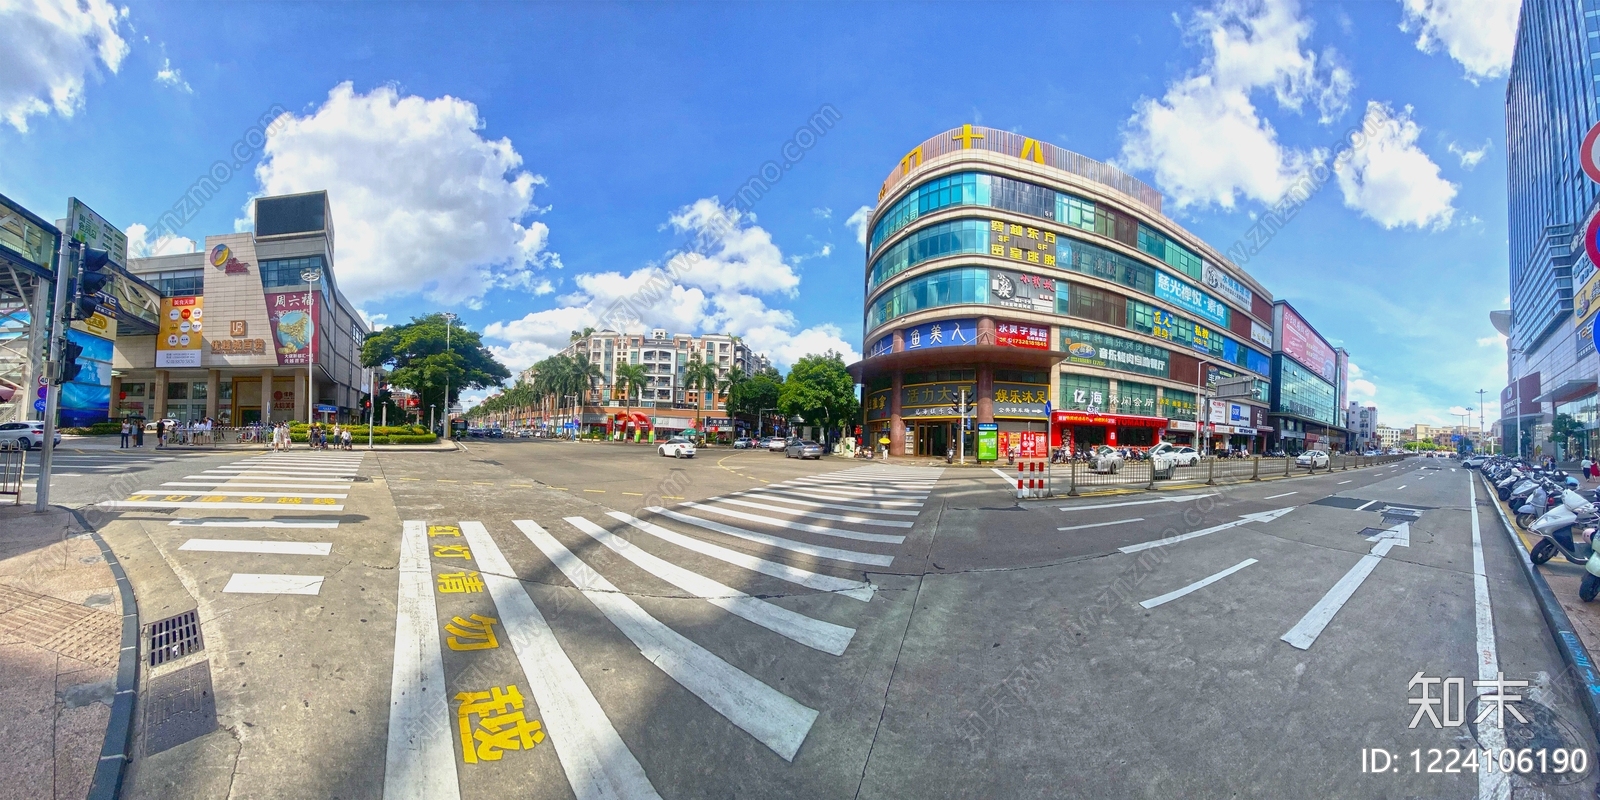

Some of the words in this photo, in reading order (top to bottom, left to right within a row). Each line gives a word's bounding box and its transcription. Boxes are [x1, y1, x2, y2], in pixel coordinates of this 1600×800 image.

[991, 244, 1056, 267] 密室逃脱
[275, 294, 315, 307] 周六福
[232, 322, 243, 332] UR
[909, 322, 966, 348] 鱼美人
[995, 389, 1047, 404] 娱乐沐足
[1074, 390, 1102, 405] 亿海
[1109, 395, 1154, 407] 休闲会所
[428, 525, 546, 764] 红灯请勿越
